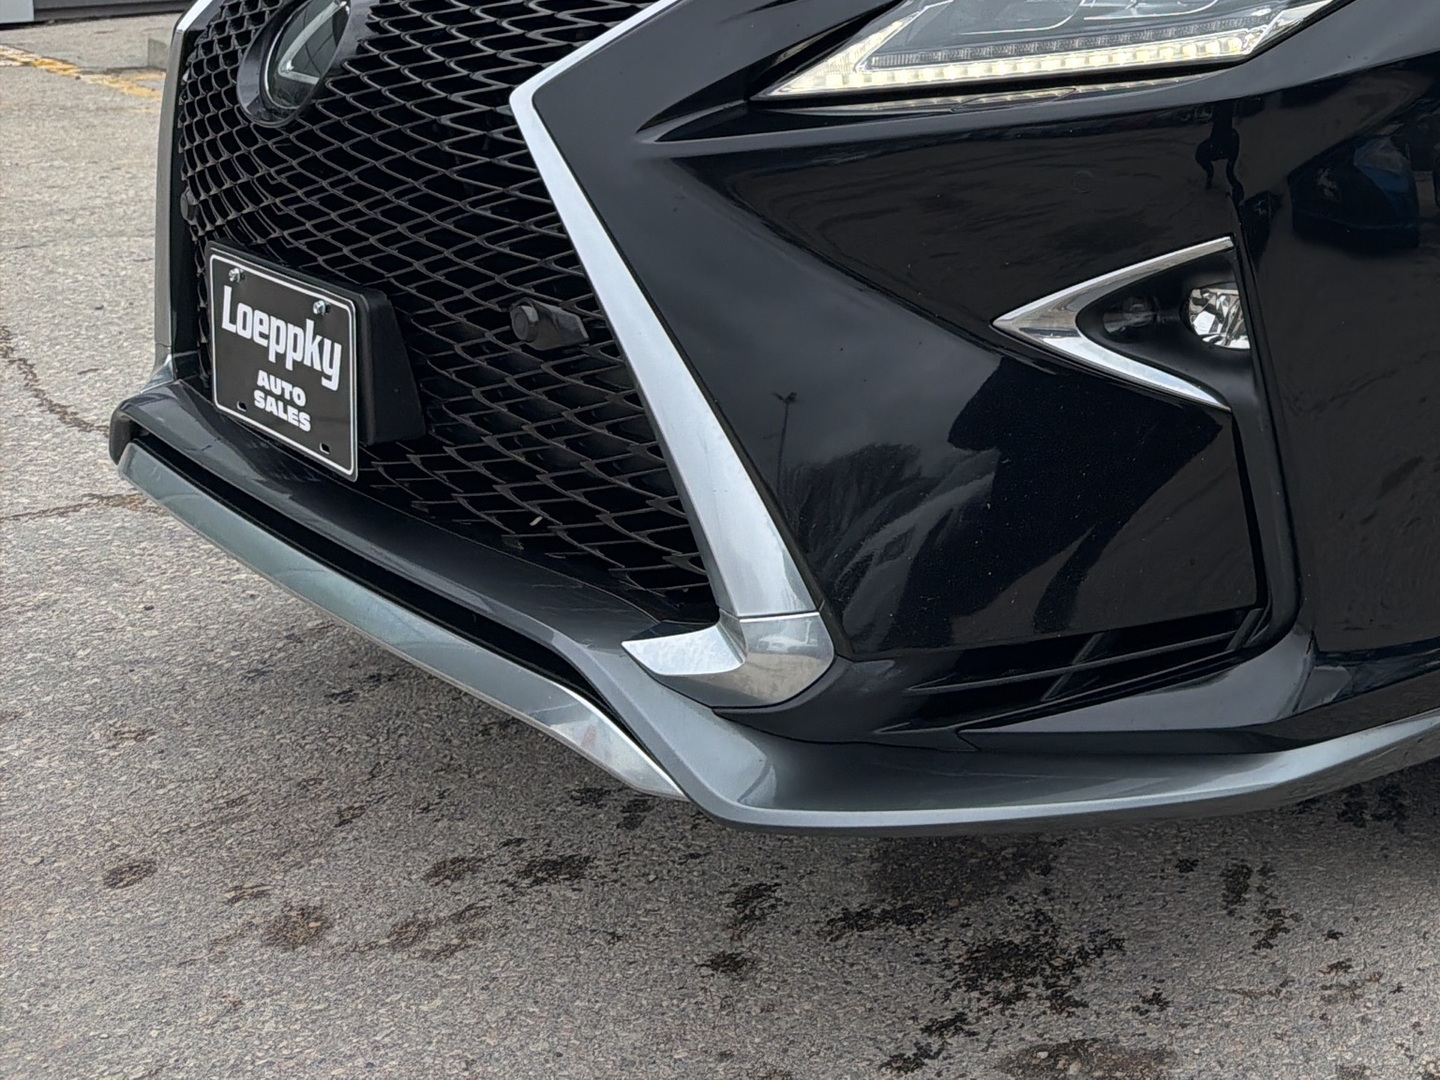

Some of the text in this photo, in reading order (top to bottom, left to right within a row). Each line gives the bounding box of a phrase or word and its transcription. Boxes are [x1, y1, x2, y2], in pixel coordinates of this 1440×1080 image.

[221, 285, 342, 391] Loeppky
[257, 369, 306, 407] AUTO
[253, 389, 311, 433] SALES
